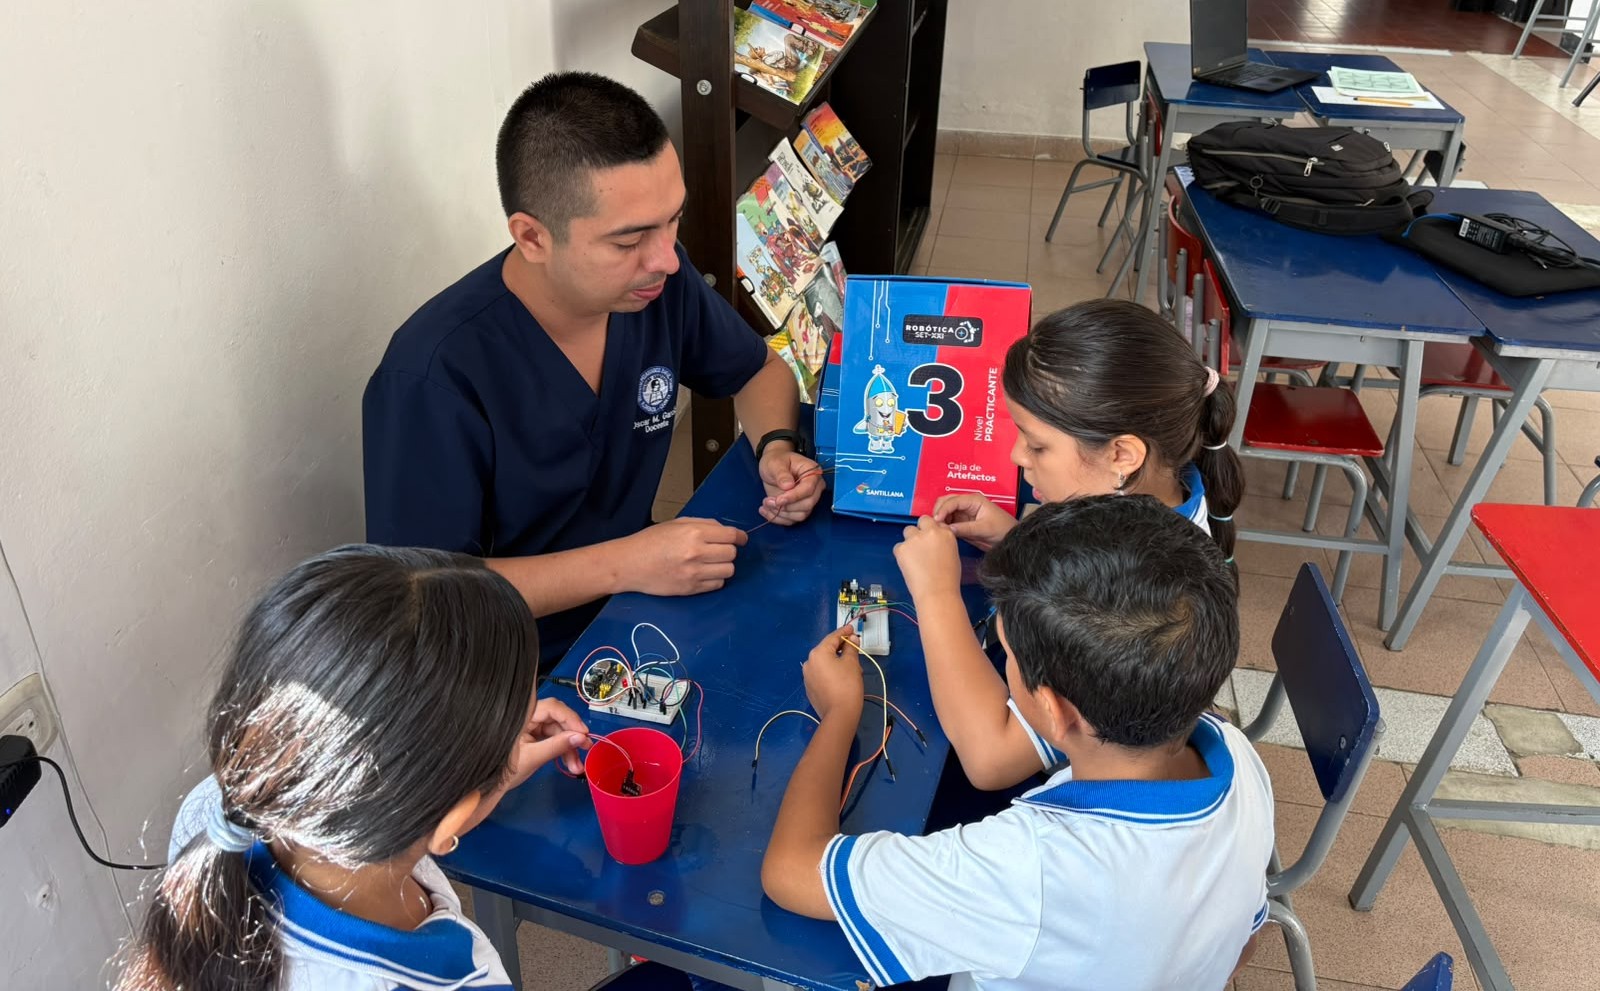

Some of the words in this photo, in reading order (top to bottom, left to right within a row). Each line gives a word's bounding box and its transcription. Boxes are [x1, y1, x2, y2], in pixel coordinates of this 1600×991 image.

[905, 324, 954, 333] ROBÓTICA
[905, 363, 964, 437] 3
[984, 367, 998, 441] PRACTICANTE
[974, 416, 984, 441] Nivel
[947, 462, 968, 472] Caja
[969, 462, 982, 472] de
[947, 472, 997, 482] Artefactos
[866, 489, 904, 498] SANTILLANA
